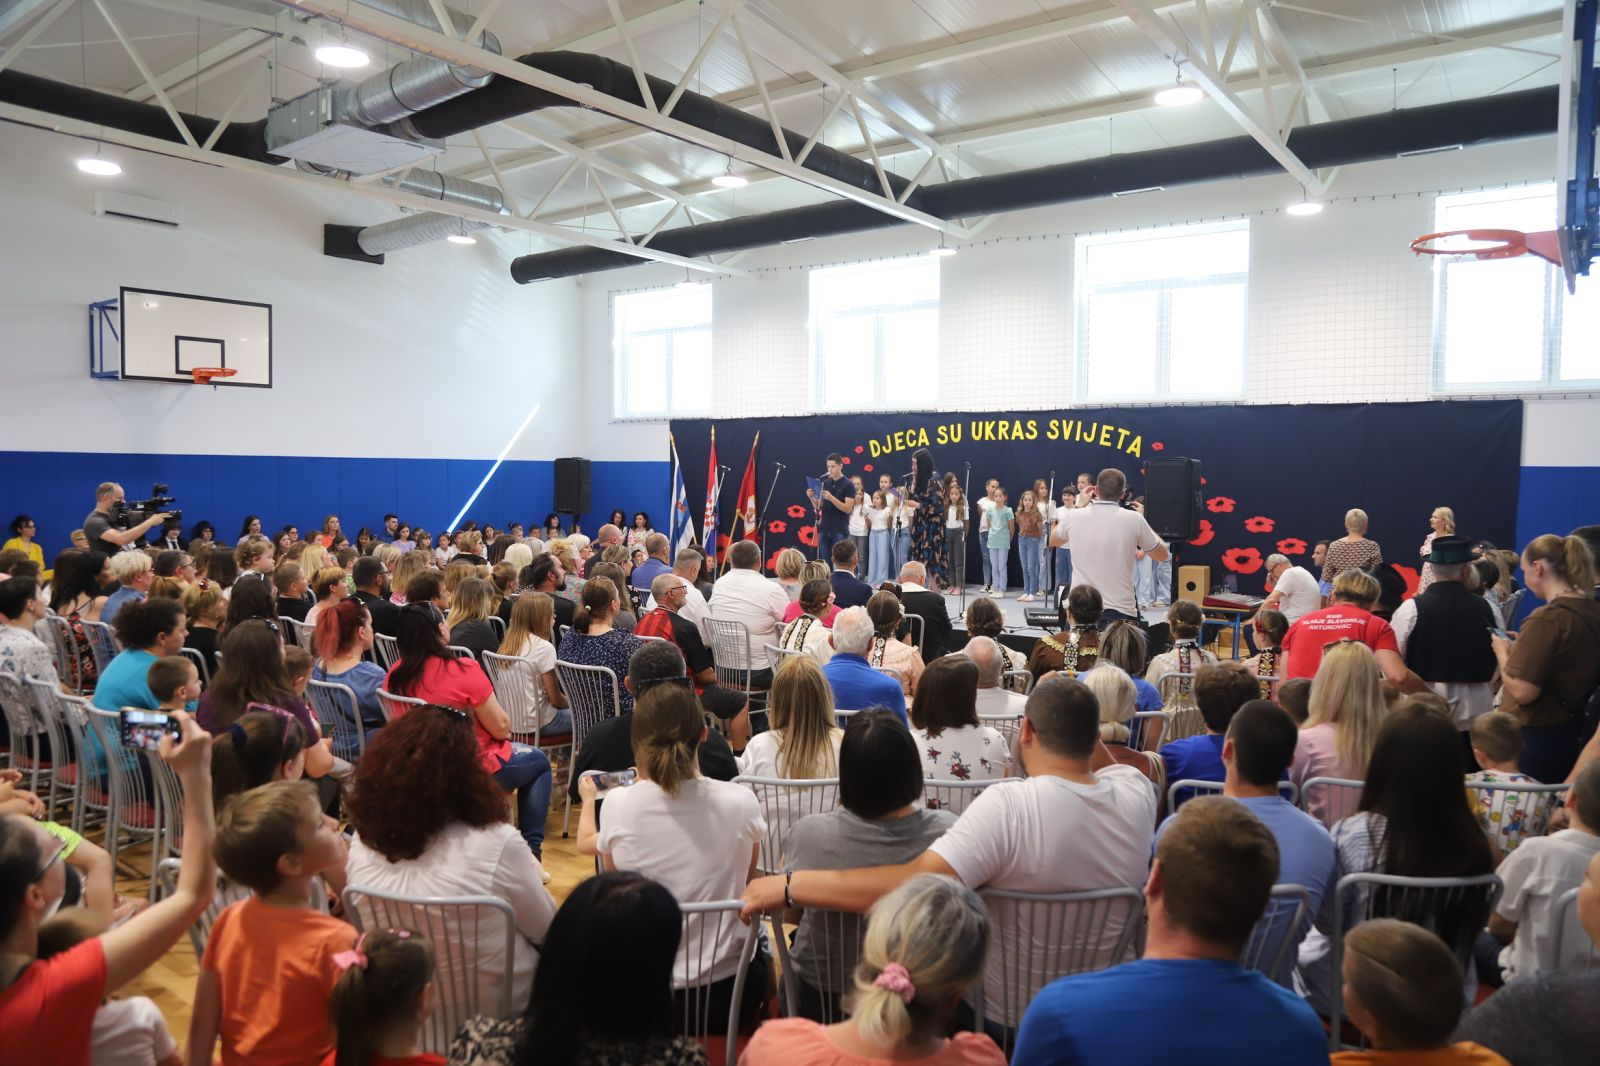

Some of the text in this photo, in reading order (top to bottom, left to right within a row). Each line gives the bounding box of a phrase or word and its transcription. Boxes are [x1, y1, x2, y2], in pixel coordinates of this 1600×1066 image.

[869, 419, 1142, 458] DJECA SU UKRAS SVIJETA
